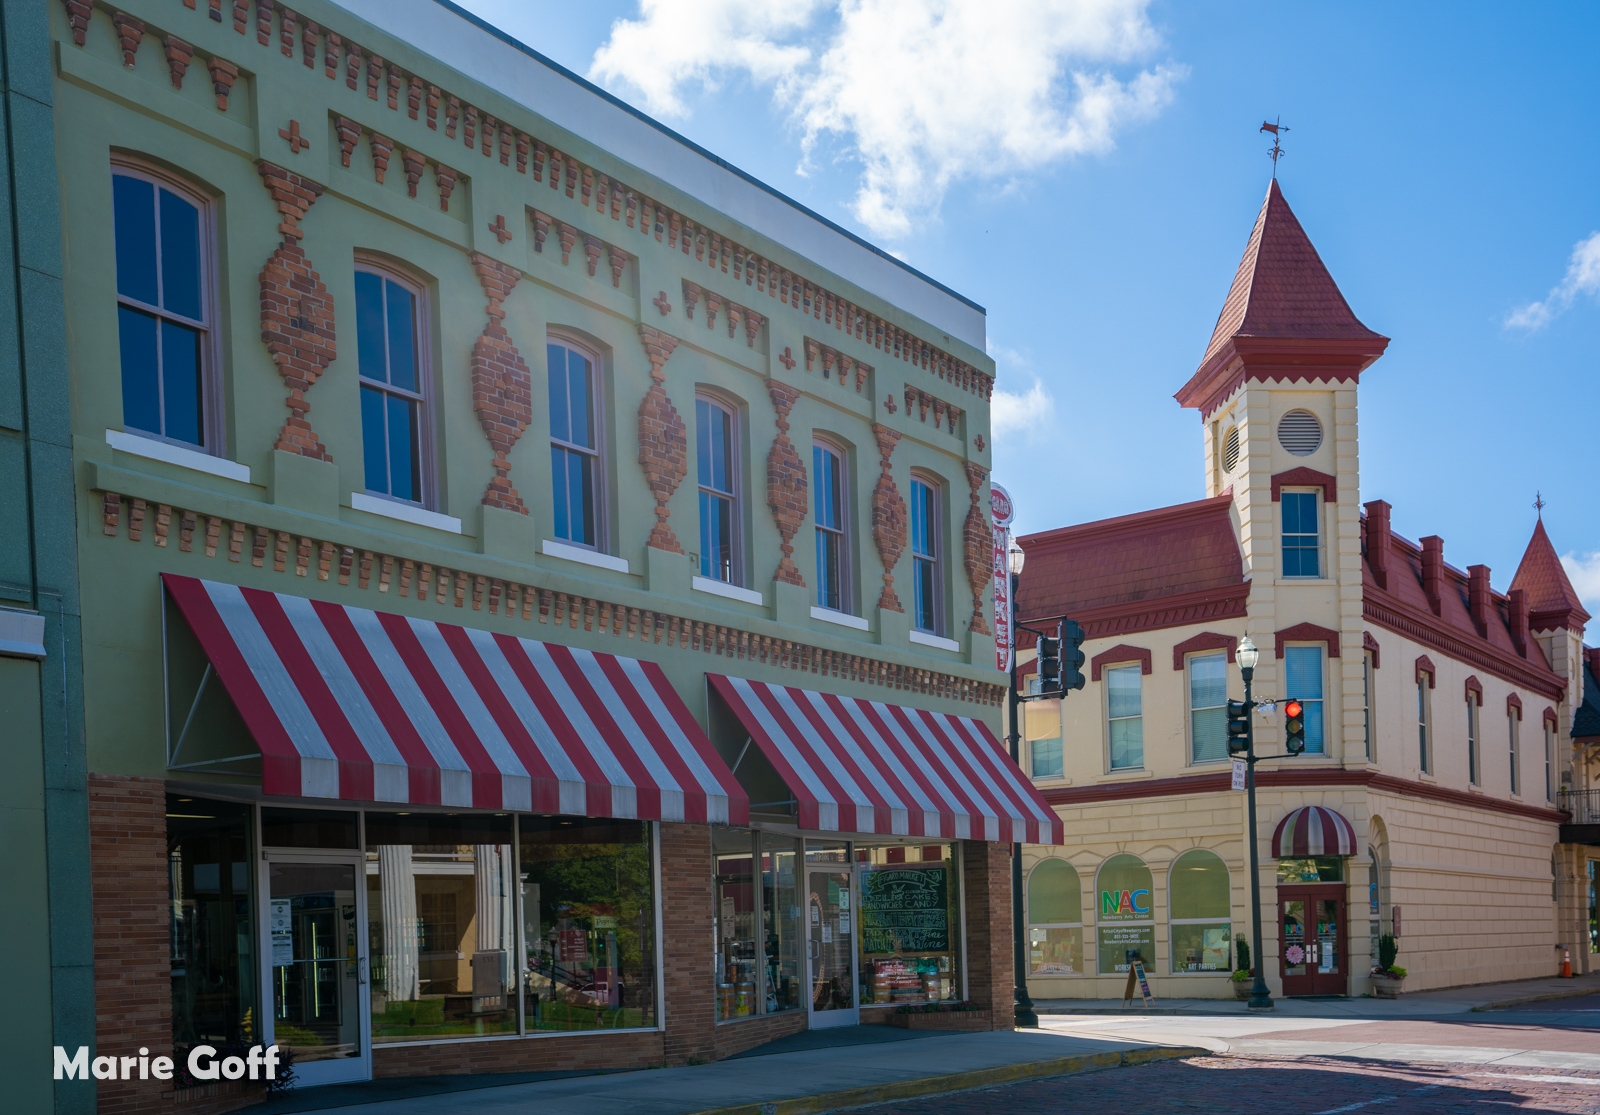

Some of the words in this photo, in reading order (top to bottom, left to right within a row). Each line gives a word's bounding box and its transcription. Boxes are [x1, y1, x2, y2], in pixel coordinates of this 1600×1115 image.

[992, 496, 1009, 515] GARO
[994, 528, 1008, 668] MARKET
[879, 872, 899, 883] FIGARO
[899, 872, 923, 883] MARKET
[905, 900, 938, 908] CANDY
[1102, 889, 1149, 914] NAC
[1285, 924, 1303, 934] NAC
[1318, 923, 1336, 932] NAC
[863, 938, 886, 951] MATCH
